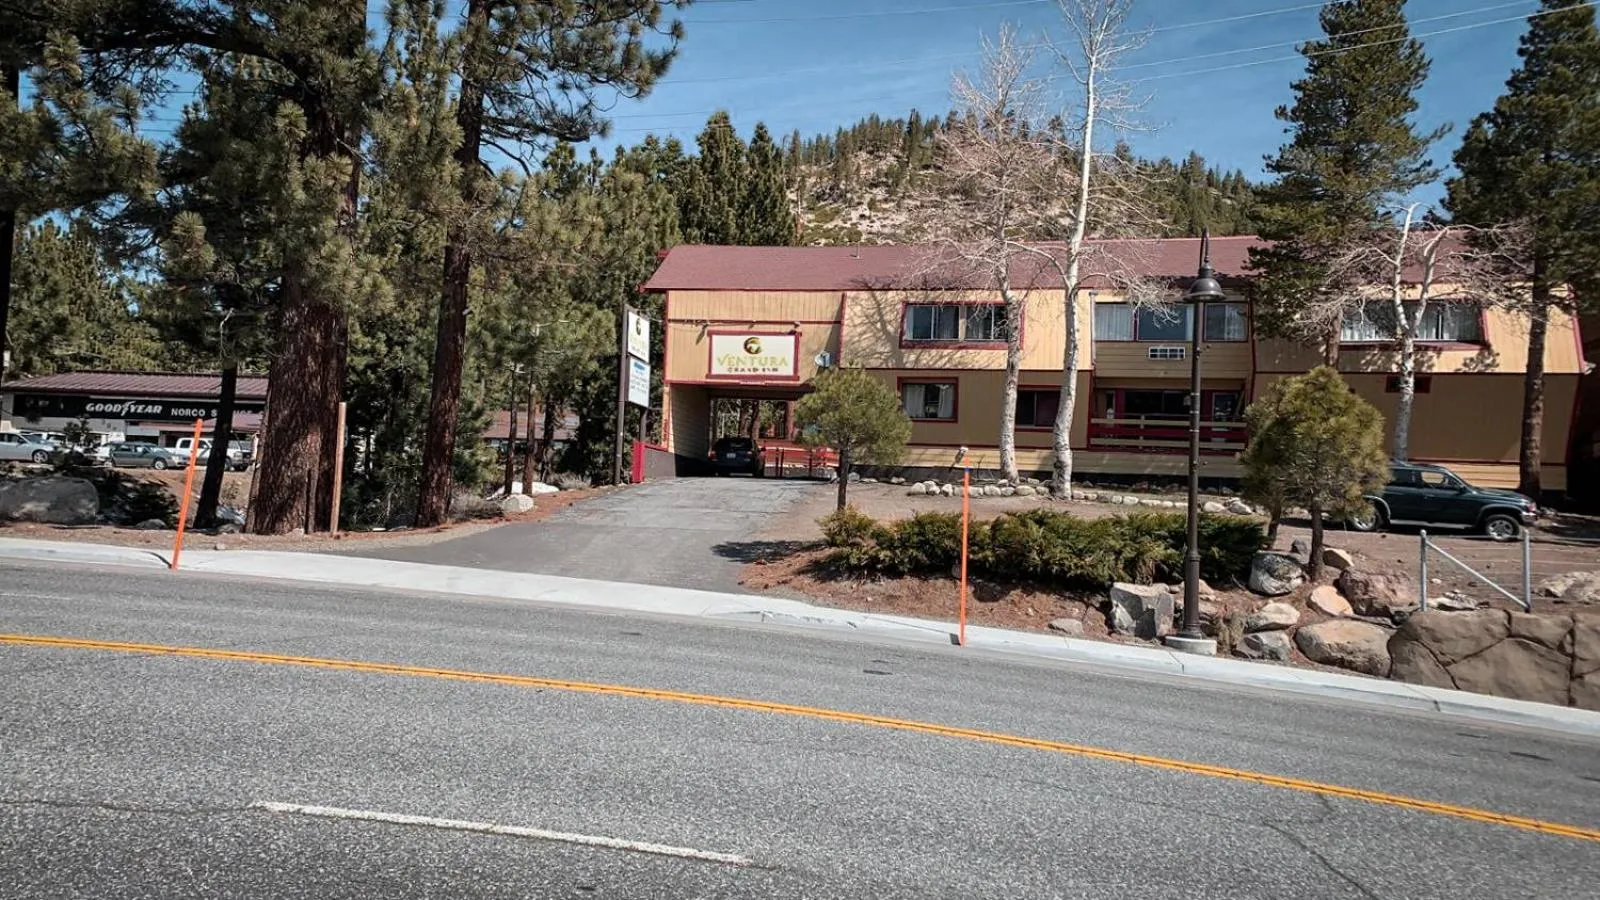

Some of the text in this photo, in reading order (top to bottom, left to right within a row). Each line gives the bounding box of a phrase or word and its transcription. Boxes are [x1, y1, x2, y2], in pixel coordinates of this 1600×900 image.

[717, 353, 788, 367] VENTURA
[85, 401, 162, 416] GOODYEAR
[171, 407, 206, 417] NORCO
